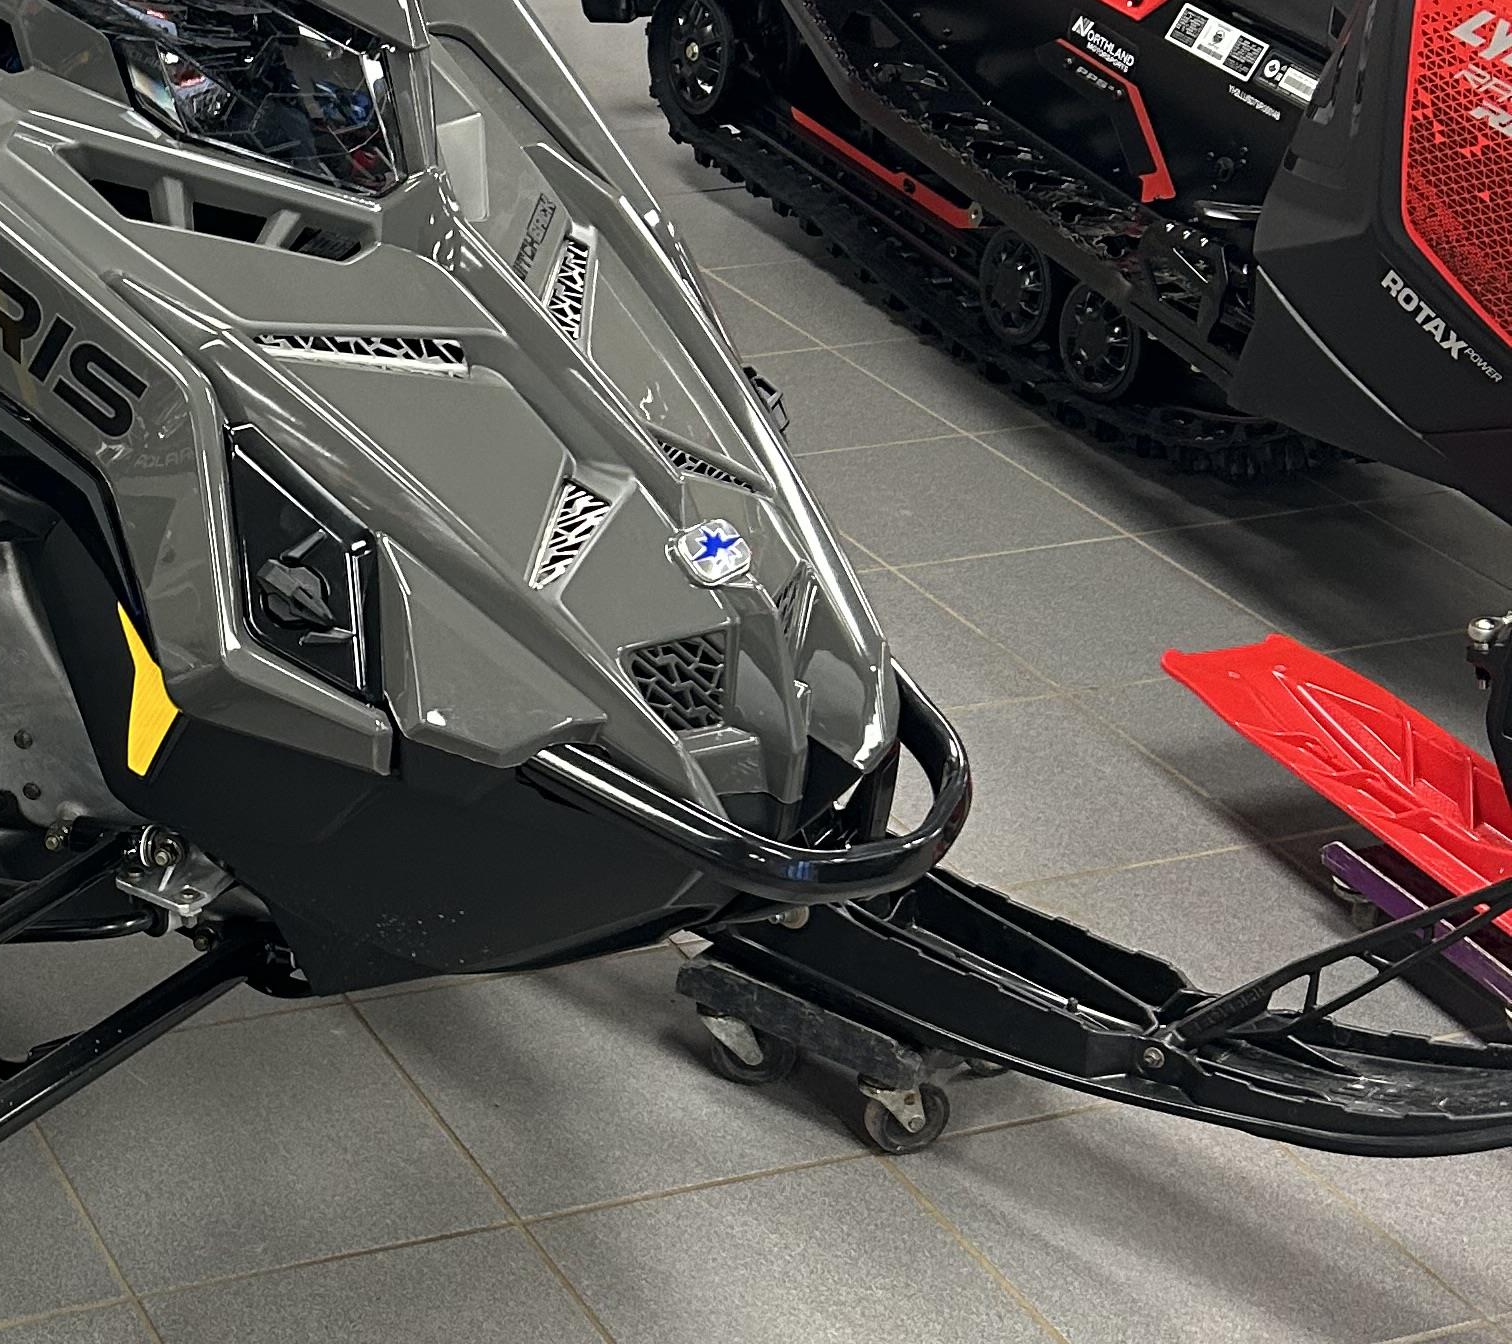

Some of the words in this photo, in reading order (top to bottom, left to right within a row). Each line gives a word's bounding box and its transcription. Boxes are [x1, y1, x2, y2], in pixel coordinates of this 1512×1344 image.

[1071, 15, 1135, 68] NORTHLAND
[1086, 40, 1129, 73] MOTORSPORTS
[1449, 9, 1512, 68] LY
[1380, 269, 1469, 360] ROTAX
[1463, 346, 1503, 383] POWER
